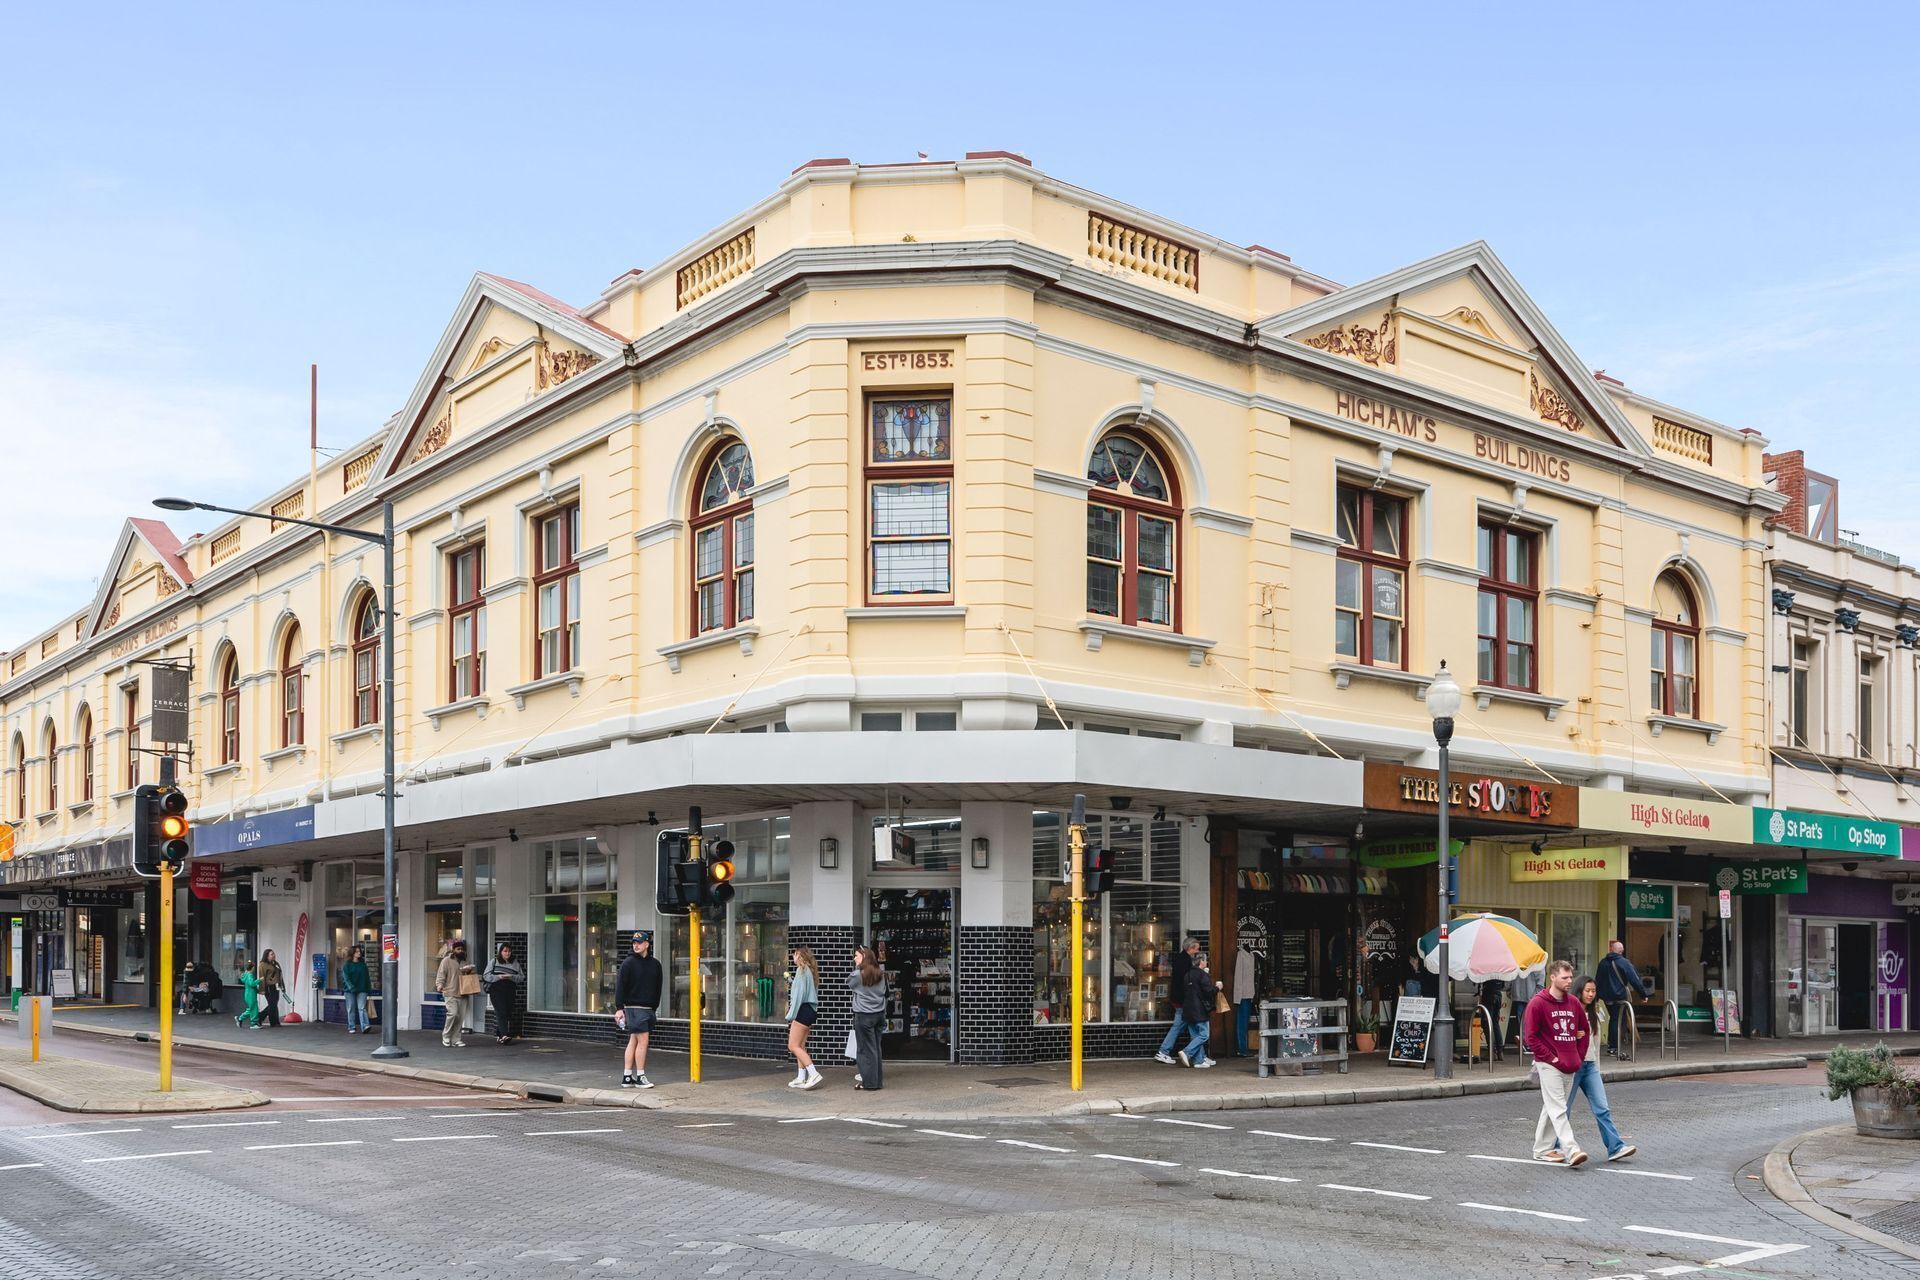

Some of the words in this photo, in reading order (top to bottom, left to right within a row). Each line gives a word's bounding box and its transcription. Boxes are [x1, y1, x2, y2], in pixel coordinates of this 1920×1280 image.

[1402, 777, 1462, 805] THRE
[1468, 779, 1551, 818] STORIES
[1631, 804, 1659, 828] High
[1661, 806, 1674, 824] St
[1675, 808, 1710, 831] Gelato
[238, 831, 261, 844] OPALS
[1787, 819, 1798, 836] St
[1799, 820, 1823, 840] Pat's
[1848, 826, 1862, 847] Op
[1863, 828, 1887, 849] Shop
[1524, 860, 1551, 874] High
[1554, 859, 1565, 870] St
[1568, 858, 1606, 870] Gelato
[1742, 868, 1757, 881] St
[1762, 866, 1798, 880] Pat's
[262, 877, 278, 887] HC
[1753, 881, 1771, 889] Shop
[1640, 893, 1648, 903] St
[1648, 893, 1664, 904] Pat's
